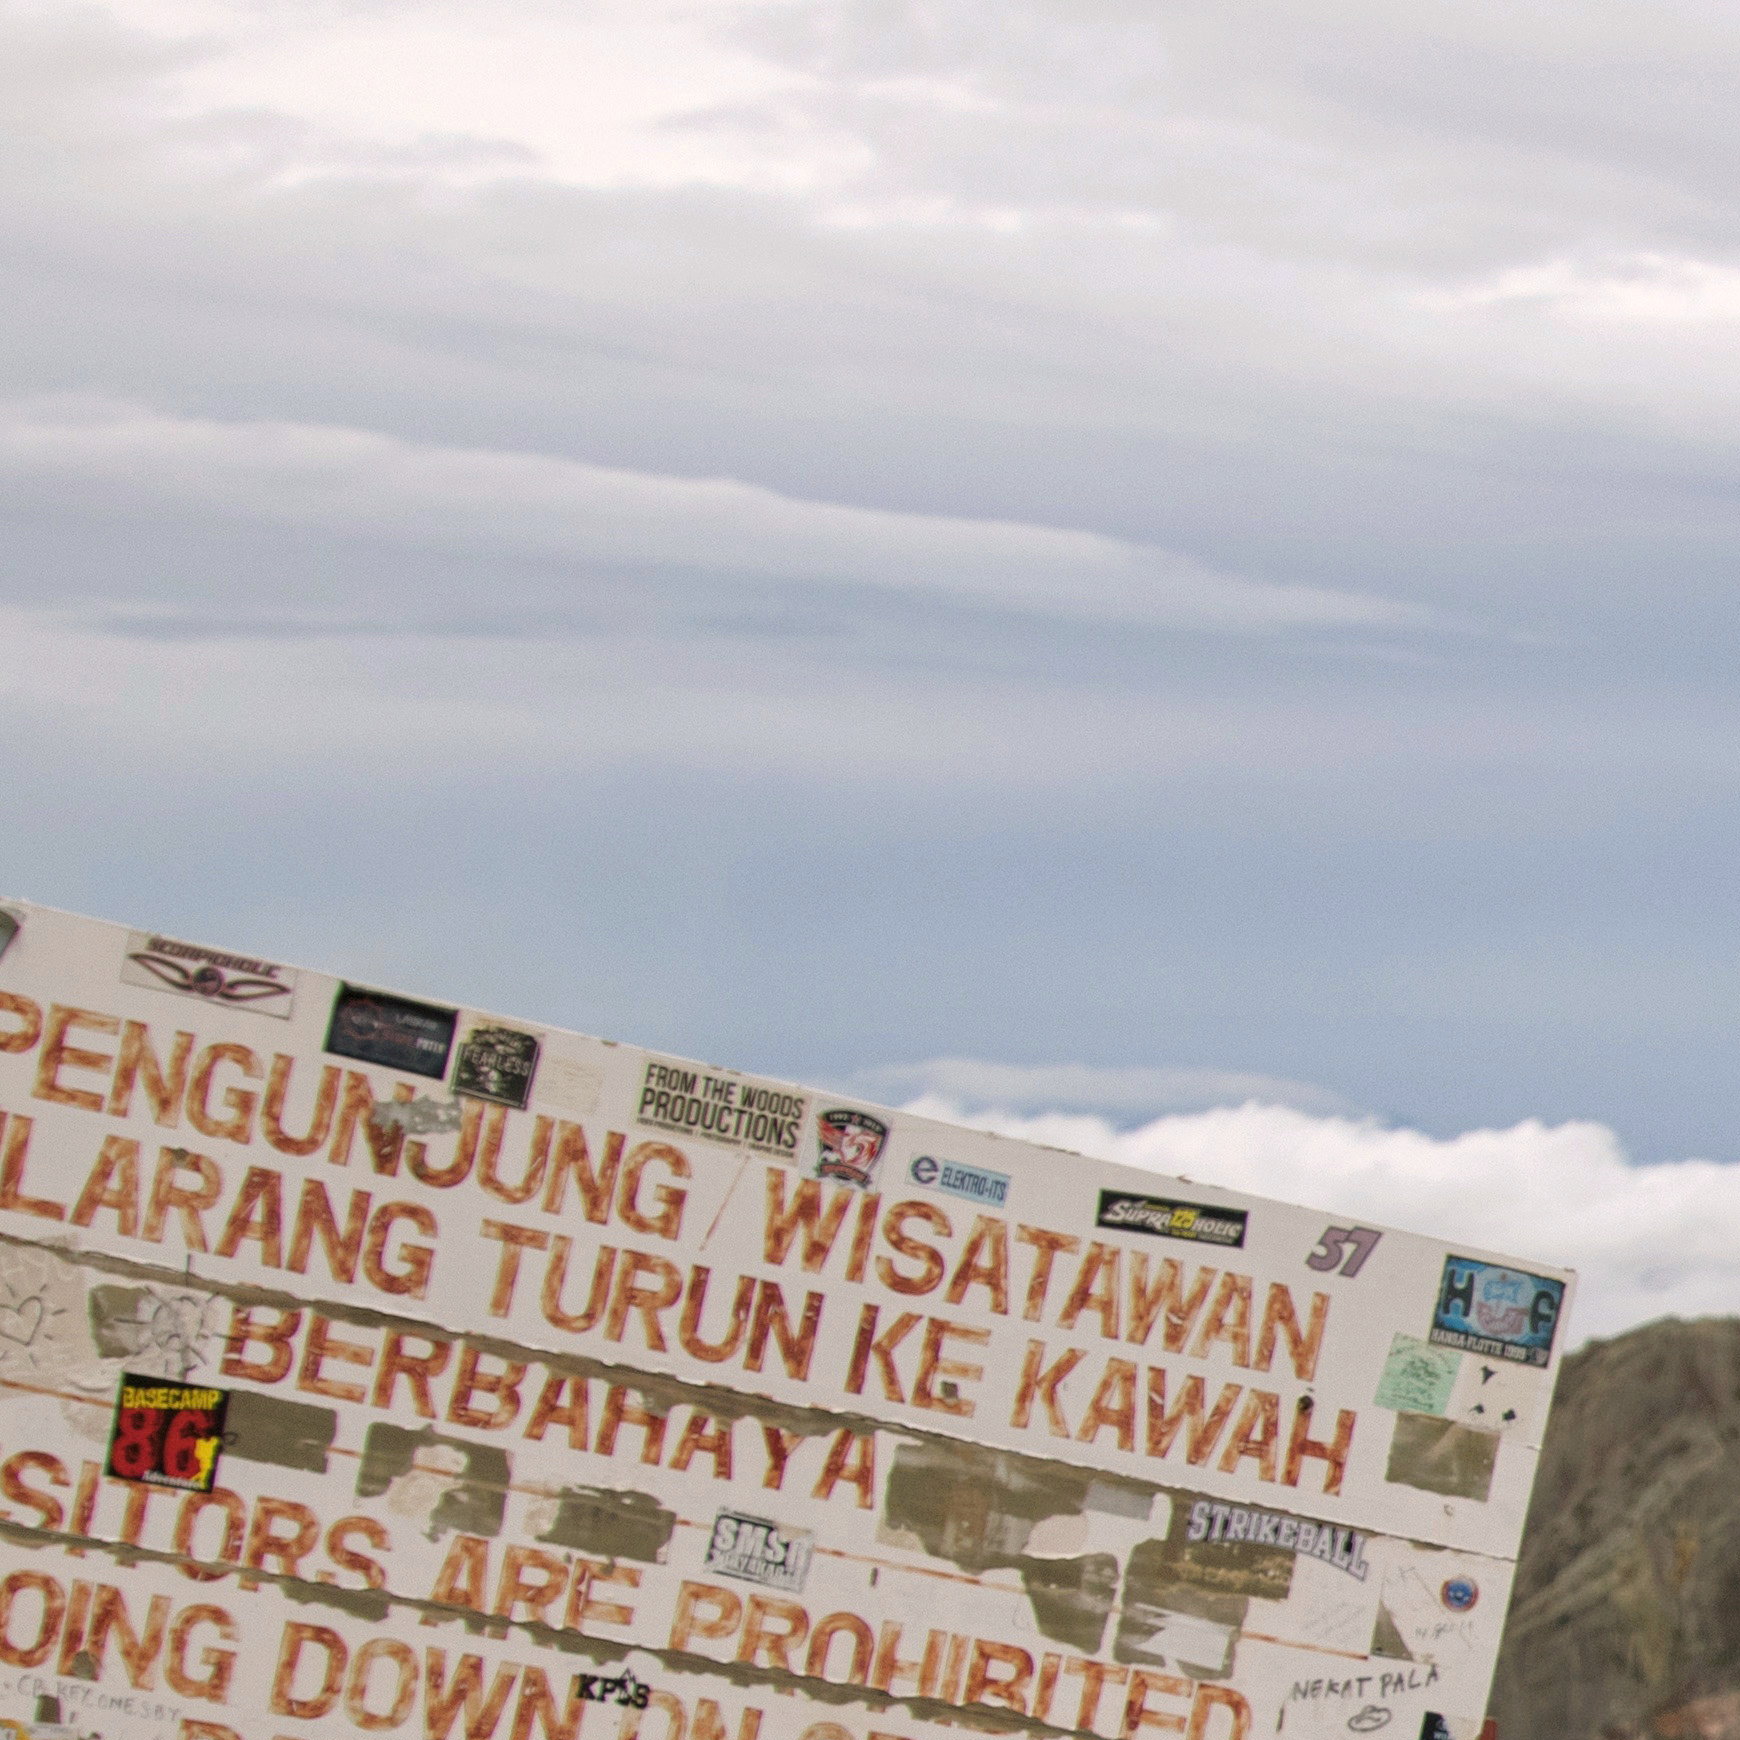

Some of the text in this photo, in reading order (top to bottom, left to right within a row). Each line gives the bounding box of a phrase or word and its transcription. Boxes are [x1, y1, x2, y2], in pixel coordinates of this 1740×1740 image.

[638, 1087, 799, 1149] PRODUCTIONS
[645, 1063, 805, 1120] FROM THE WOODS
[941, 1166, 1007, 1202] ELEKTRO-ITS
[763, 1166, 1330, 1382] WISATAWAN
[1305, 1225, 1383, 1278] 57
[0, 1111, 1358, 1498] LARANG TURUN KE KAWAH
[122, 1386, 223, 1410] BASECAMP
[219, 1300, 875, 1511] BERBAHAYA
[110, 1408, 214, 1480] 86
[1187, 1501, 1370, 1582] STRIKEBALL
[425, 1533, 643, 1641] ARE
[0, 1569, 240, 1703] OING
